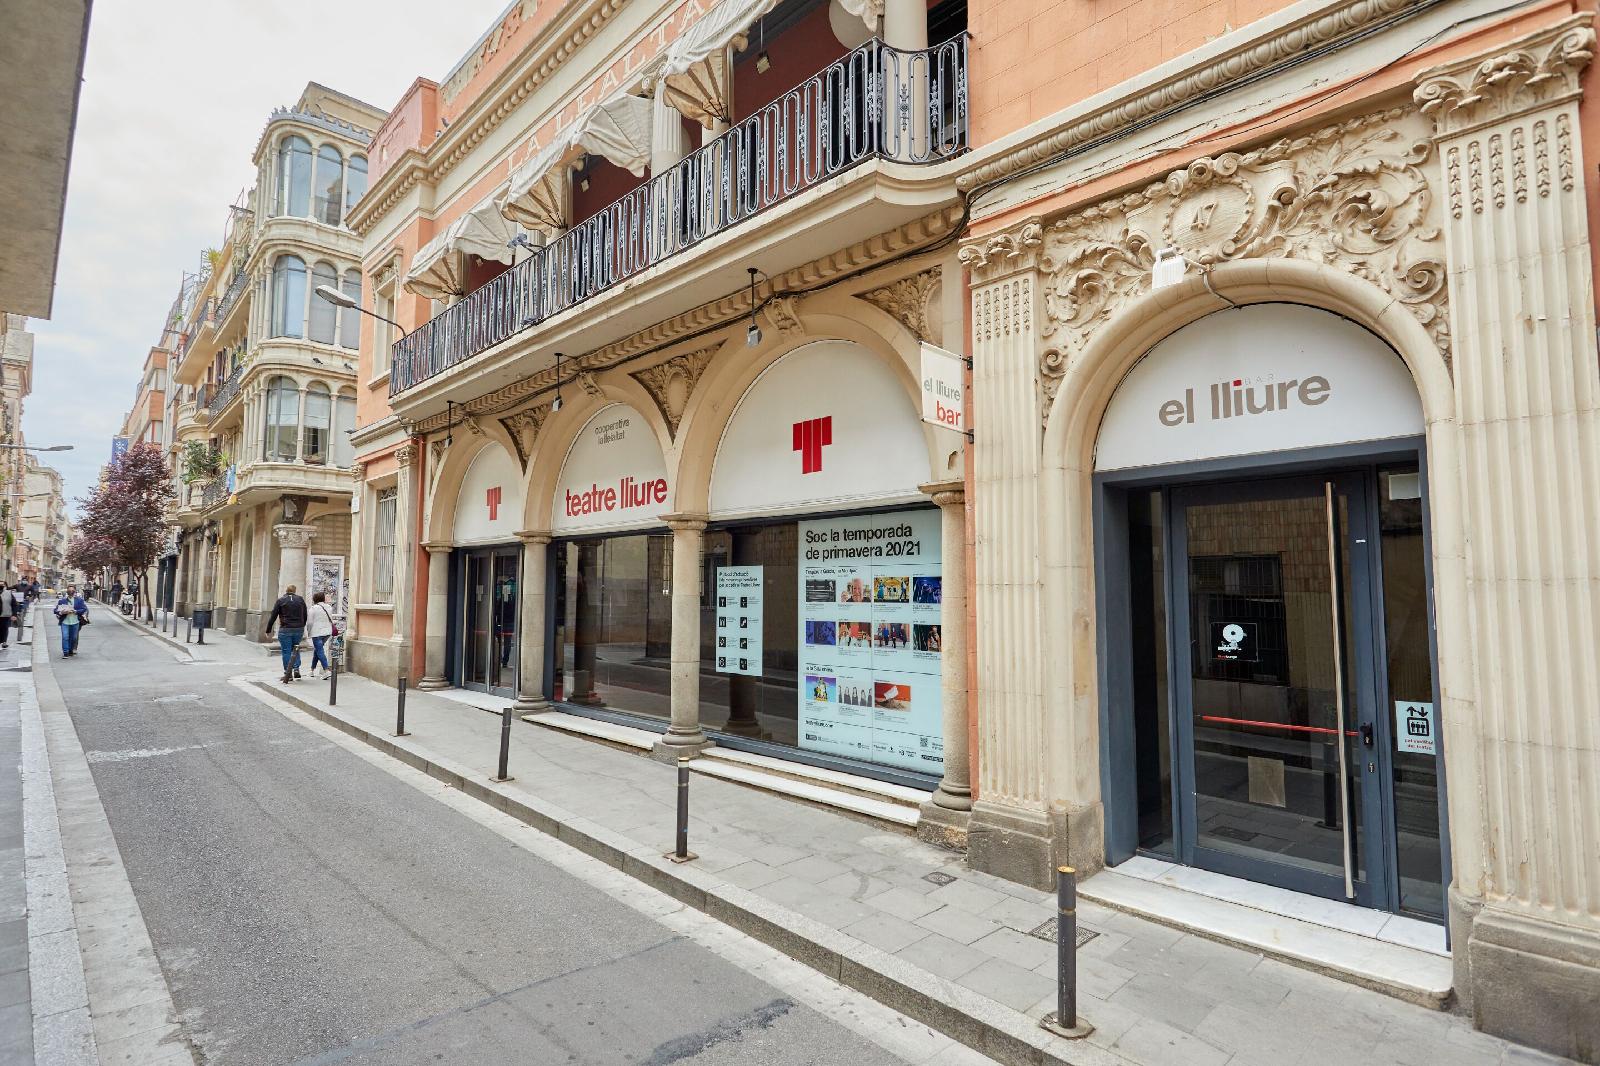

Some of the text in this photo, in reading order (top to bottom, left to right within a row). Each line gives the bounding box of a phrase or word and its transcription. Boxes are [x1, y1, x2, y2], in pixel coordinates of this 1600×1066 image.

[555, 0, 718, 137] LEALTA
[923, 377, 961, 402] el lliure
[1158, 375, 1332, 427] el lliure
[936, 400, 961, 426] bar
[565, 476, 667, 517] teatre lliure
[805, 523, 913, 543] Soc la temporada
[805, 540, 921, 562] de primavera 20/21
